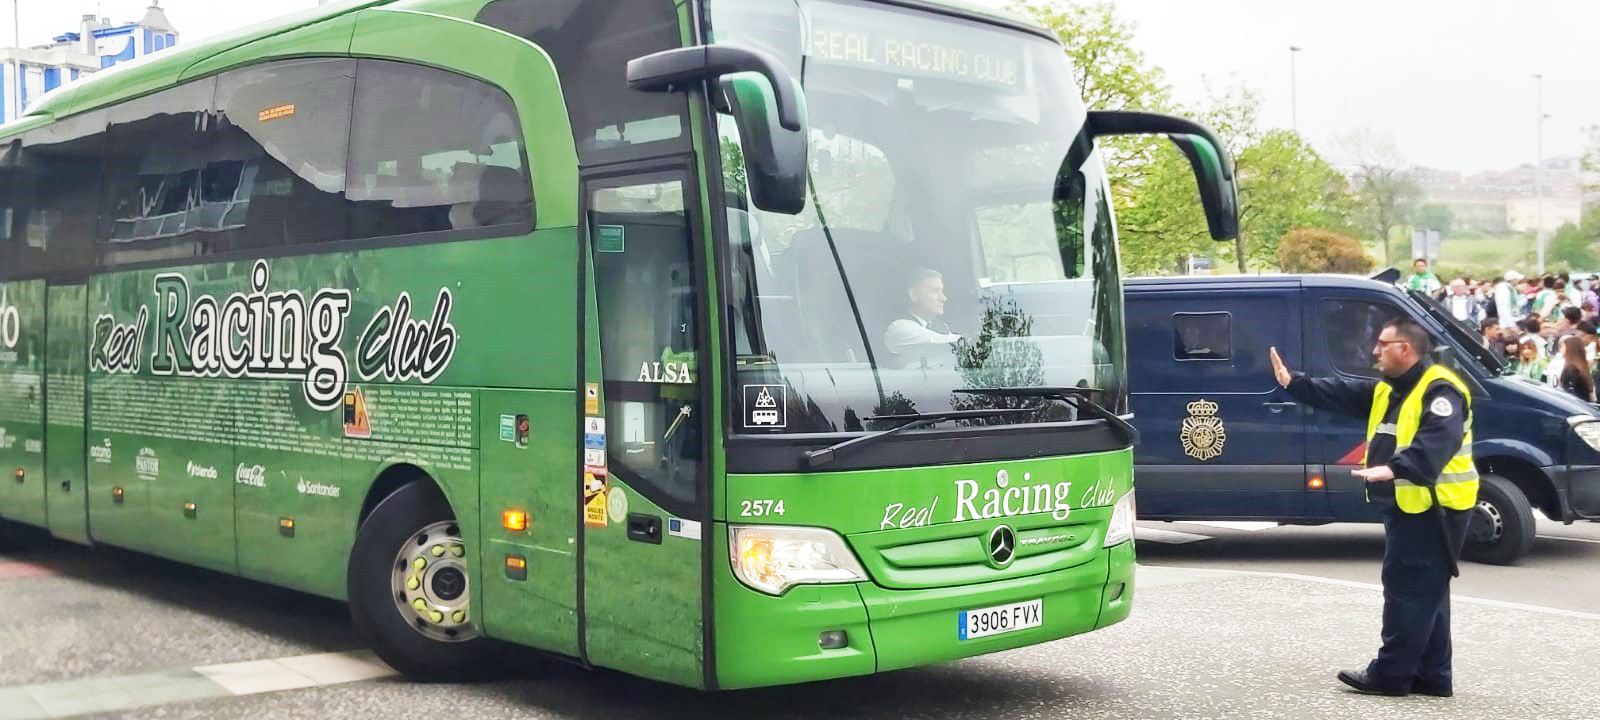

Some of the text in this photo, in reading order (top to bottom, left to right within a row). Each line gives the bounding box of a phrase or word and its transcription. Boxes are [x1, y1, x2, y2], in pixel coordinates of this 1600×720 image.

[813, 31, 1018, 86] REAL RACING CLUB
[89, 304, 149, 375] Real
[152, 258, 350, 412] Racing
[357, 287, 457, 384] Club
[637, 361, 693, 384] ALSA
[305, 480, 341, 497] Santander
[880, 495, 939, 531] Real
[952, 472, 1072, 521] Racing
[740, 499, 786, 517] 2574
[971, 603, 1039, 634] 3906 FVX
